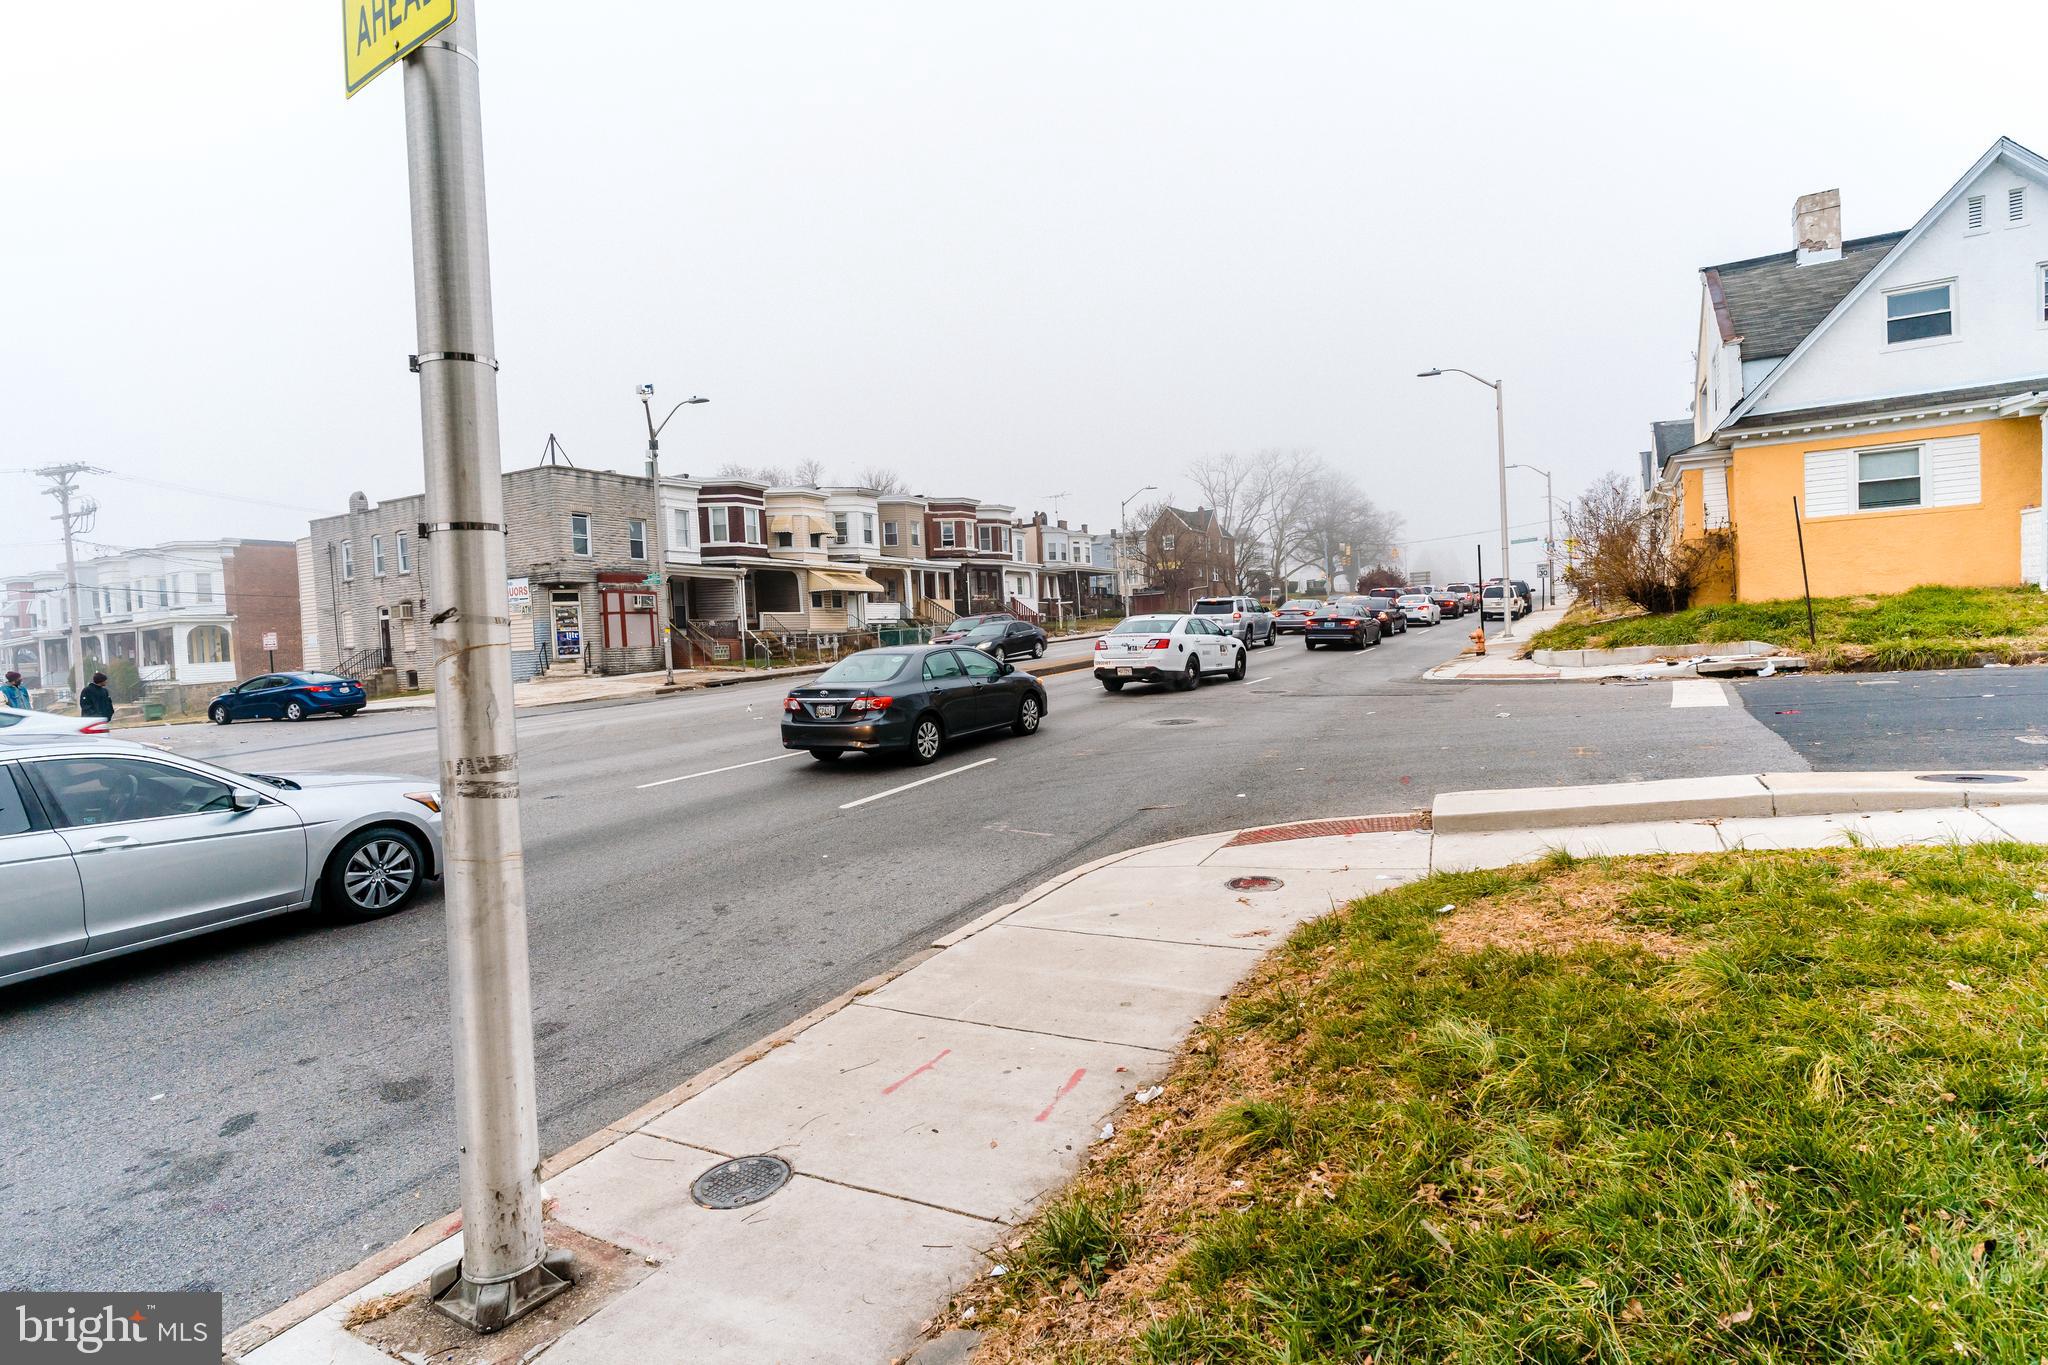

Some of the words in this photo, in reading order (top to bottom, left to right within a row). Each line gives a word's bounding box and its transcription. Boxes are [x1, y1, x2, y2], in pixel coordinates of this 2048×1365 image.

[357, 0, 433, 56] AHE
[508, 586, 528, 596] UORS
[566, 632, 579, 640] Lite
